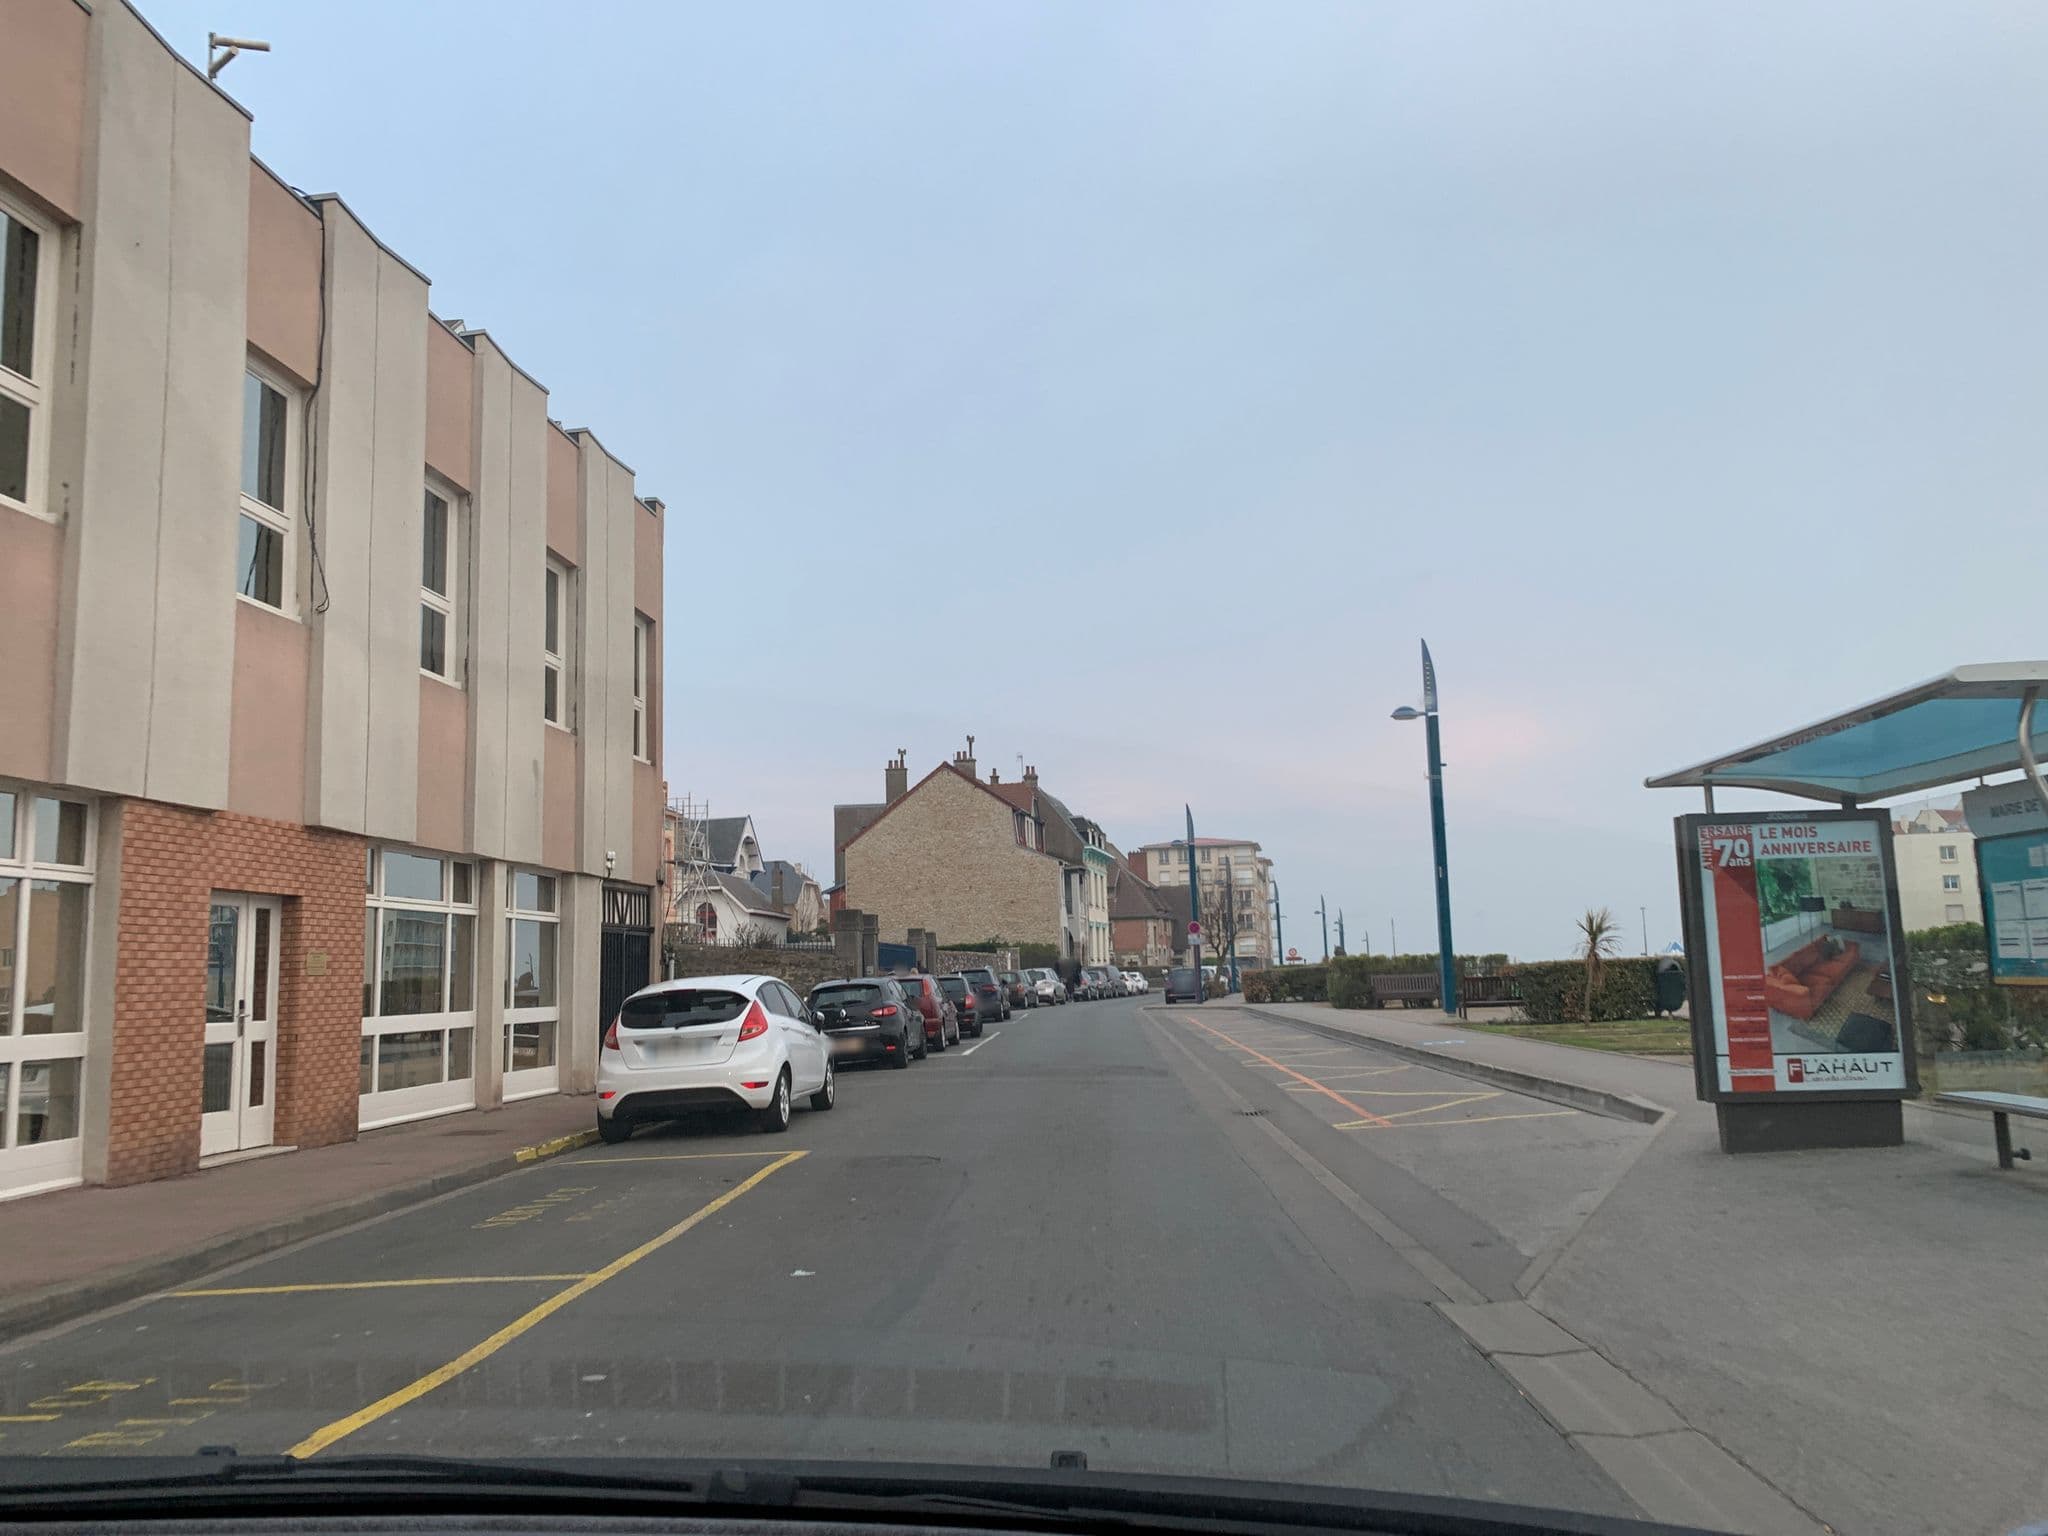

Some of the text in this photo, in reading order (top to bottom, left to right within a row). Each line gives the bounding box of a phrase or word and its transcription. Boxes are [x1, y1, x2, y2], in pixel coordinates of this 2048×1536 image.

[1759, 826, 1818, 839] LE MOIS
[1713, 838, 1750, 868] 70
[1760, 840, 1873, 856] ANNIVERSAIRE
[1729, 857, 1751, 867] ans
[1789, 1061, 1893, 1077] FLAHAUT
